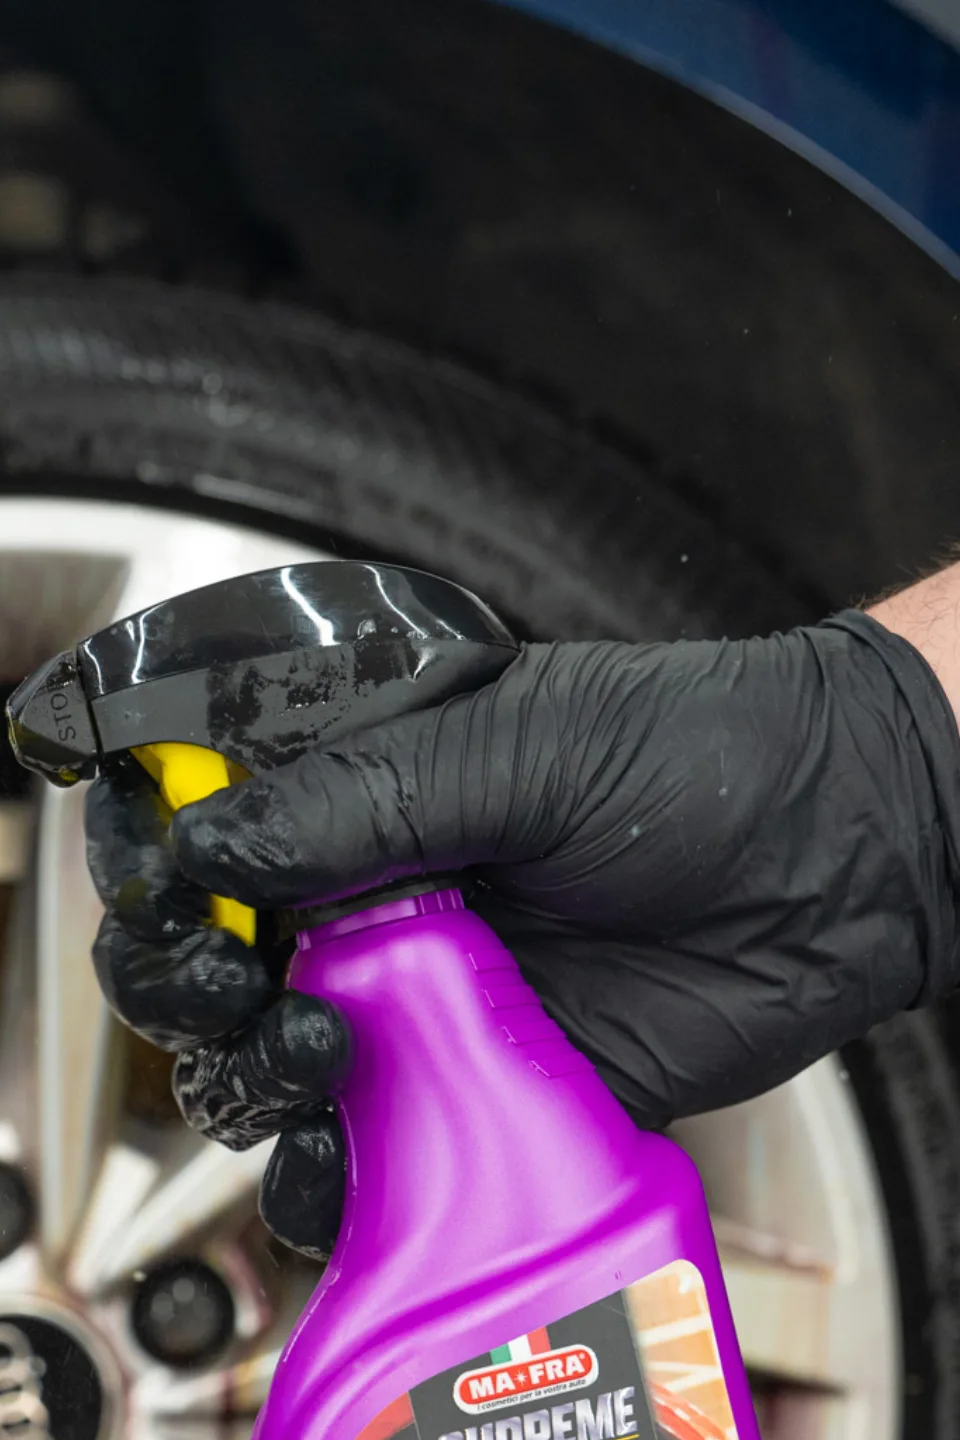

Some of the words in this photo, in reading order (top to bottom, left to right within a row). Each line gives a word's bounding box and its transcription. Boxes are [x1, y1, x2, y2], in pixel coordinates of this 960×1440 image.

[481, 1396, 518, 1410] cosmetici
[519, 1392, 533, 1404] per
[542, 1383, 567, 1395] vostra
[568, 1378, 586, 1389] auto
